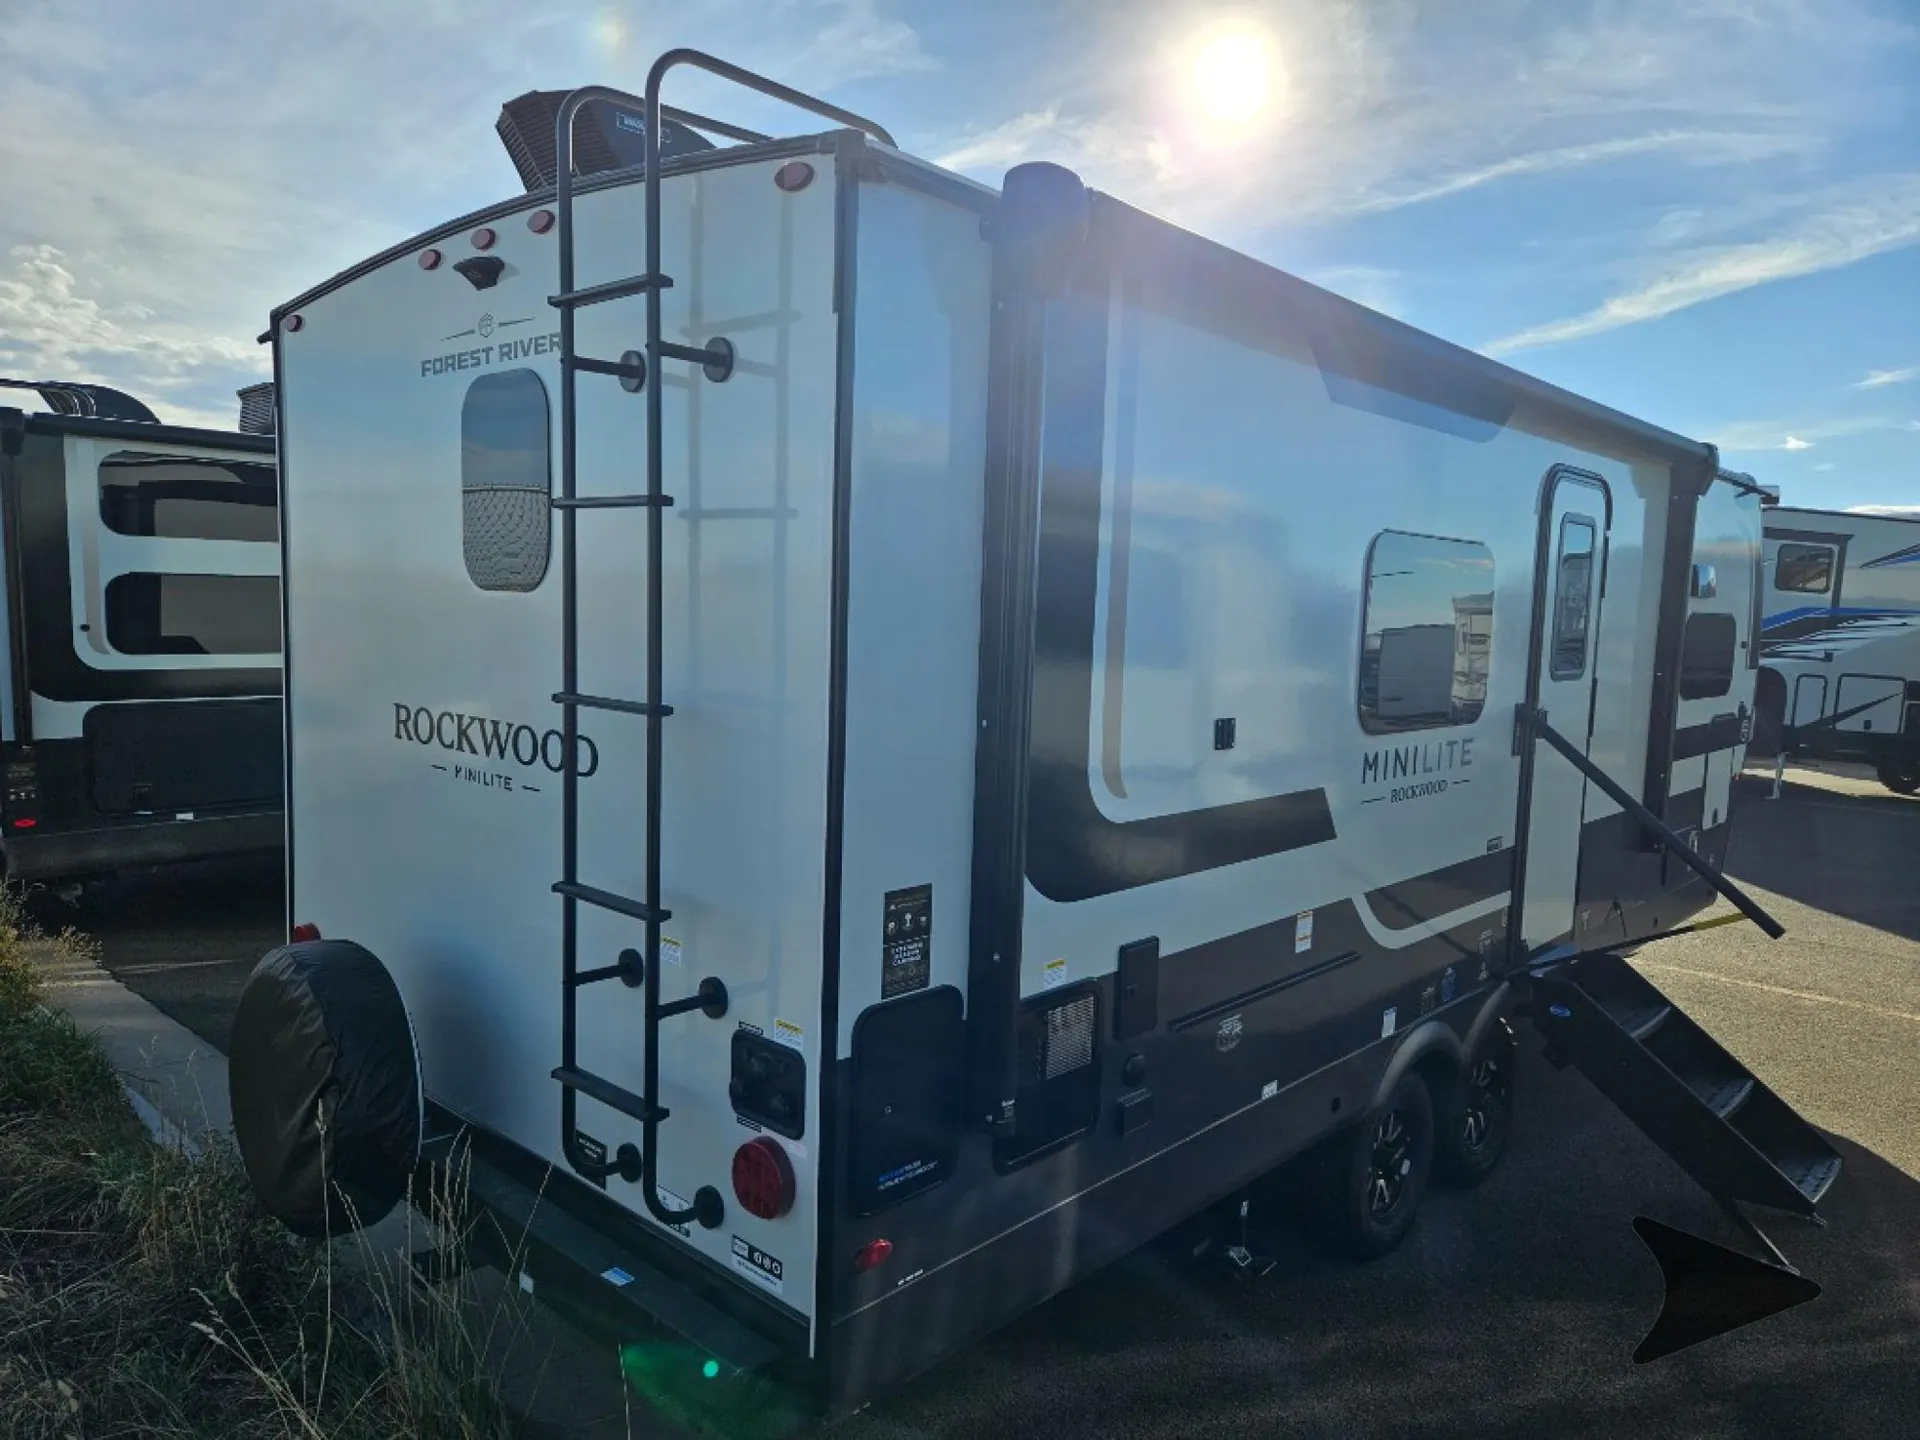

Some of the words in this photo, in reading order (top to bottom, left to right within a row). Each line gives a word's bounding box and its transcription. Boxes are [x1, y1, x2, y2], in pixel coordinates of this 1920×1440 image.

[420, 347, 494, 378] FOREST
[498, 332, 562, 362] RIVER
[393, 702, 599, 778] ROCKWOOD
[1362, 737, 1475, 785] MINILITE
[454, 764, 513, 792] MINILITE
[1390, 779, 1449, 804] ROCKWOOD
